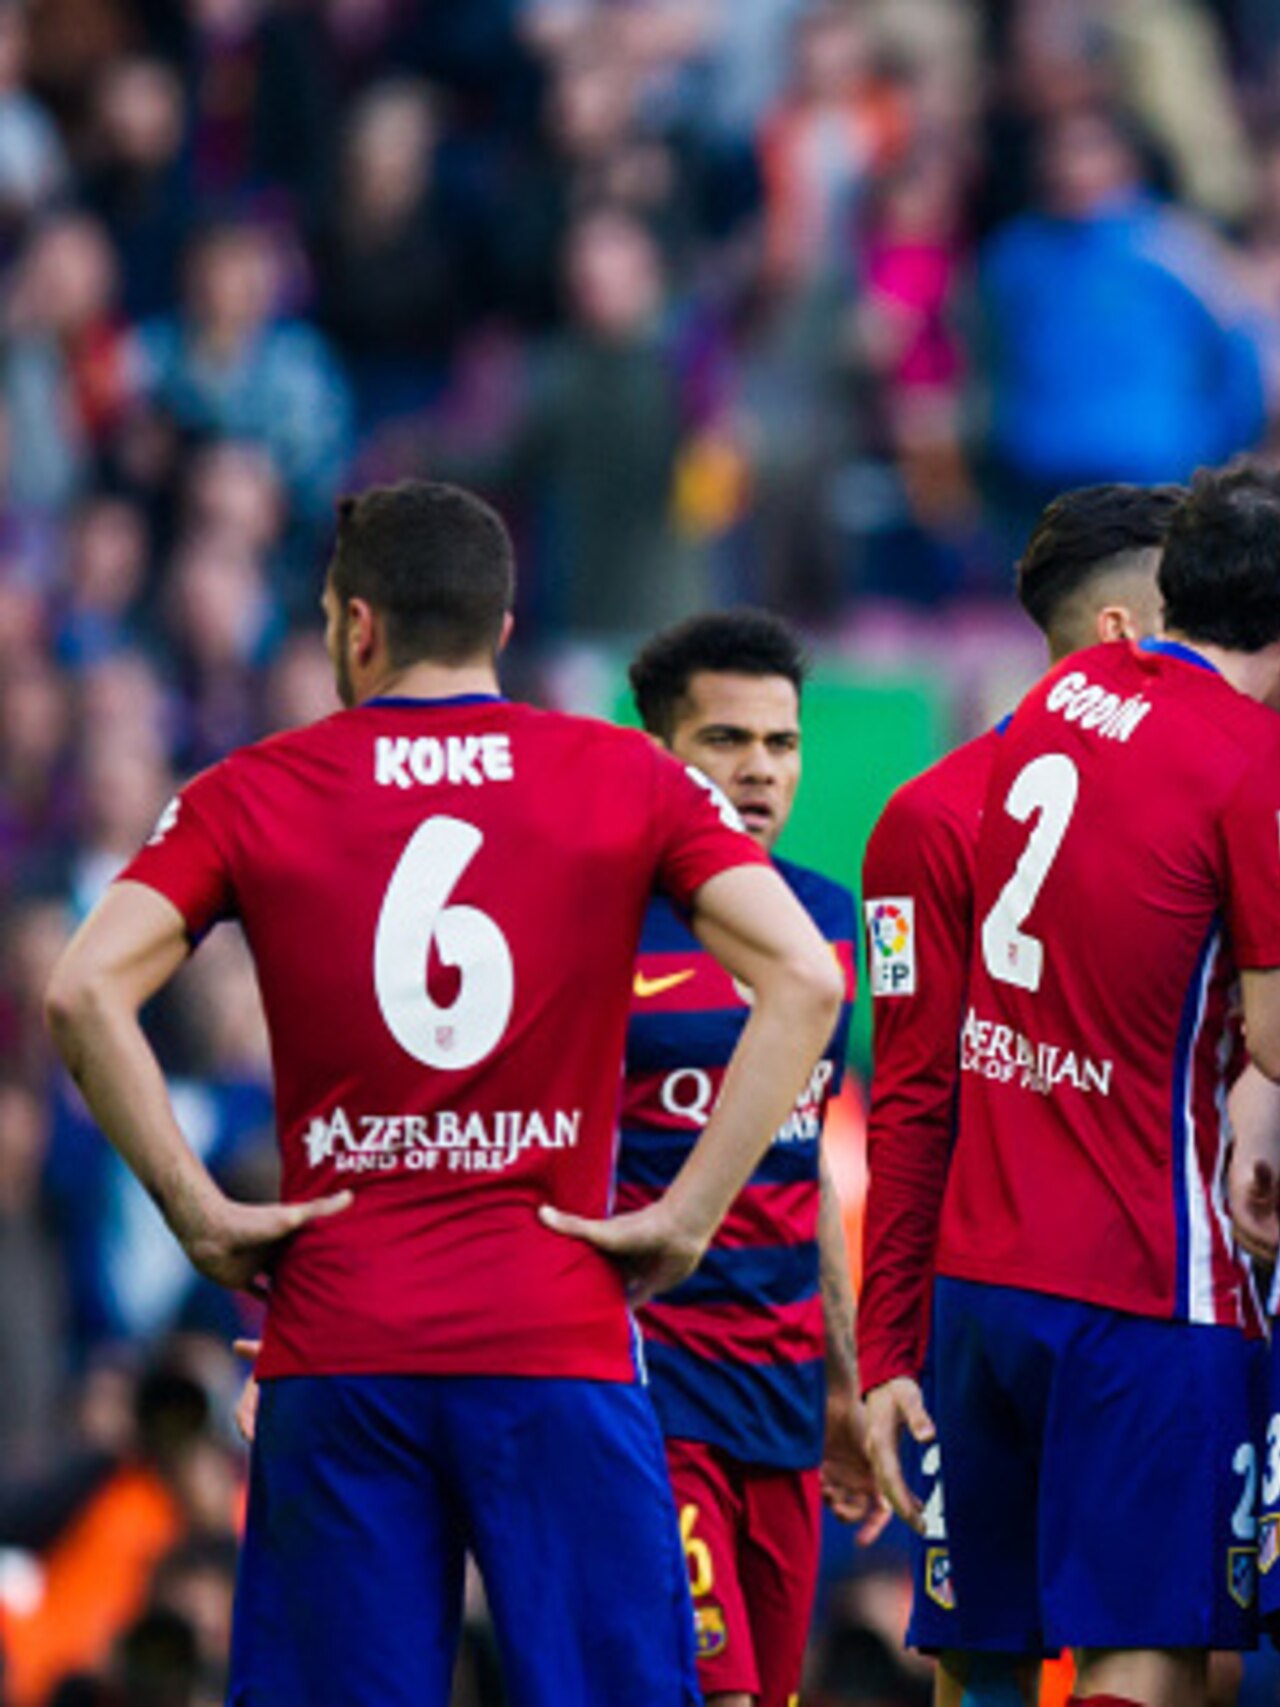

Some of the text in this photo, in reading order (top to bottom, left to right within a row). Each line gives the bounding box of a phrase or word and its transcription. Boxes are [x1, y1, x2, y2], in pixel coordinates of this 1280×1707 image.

[374, 733, 514, 789] KOKE
[982, 753, 1079, 993] 2
[374, 814, 514, 1071] 6
[326, 1106, 582, 1164] AZERBAIJAN
[404, 1150, 440, 1170] OF
[448, 1150, 507, 1171] FIRE
[1231, 1441, 1258, 1541] 2
[679, 1504, 714, 1597] 6
